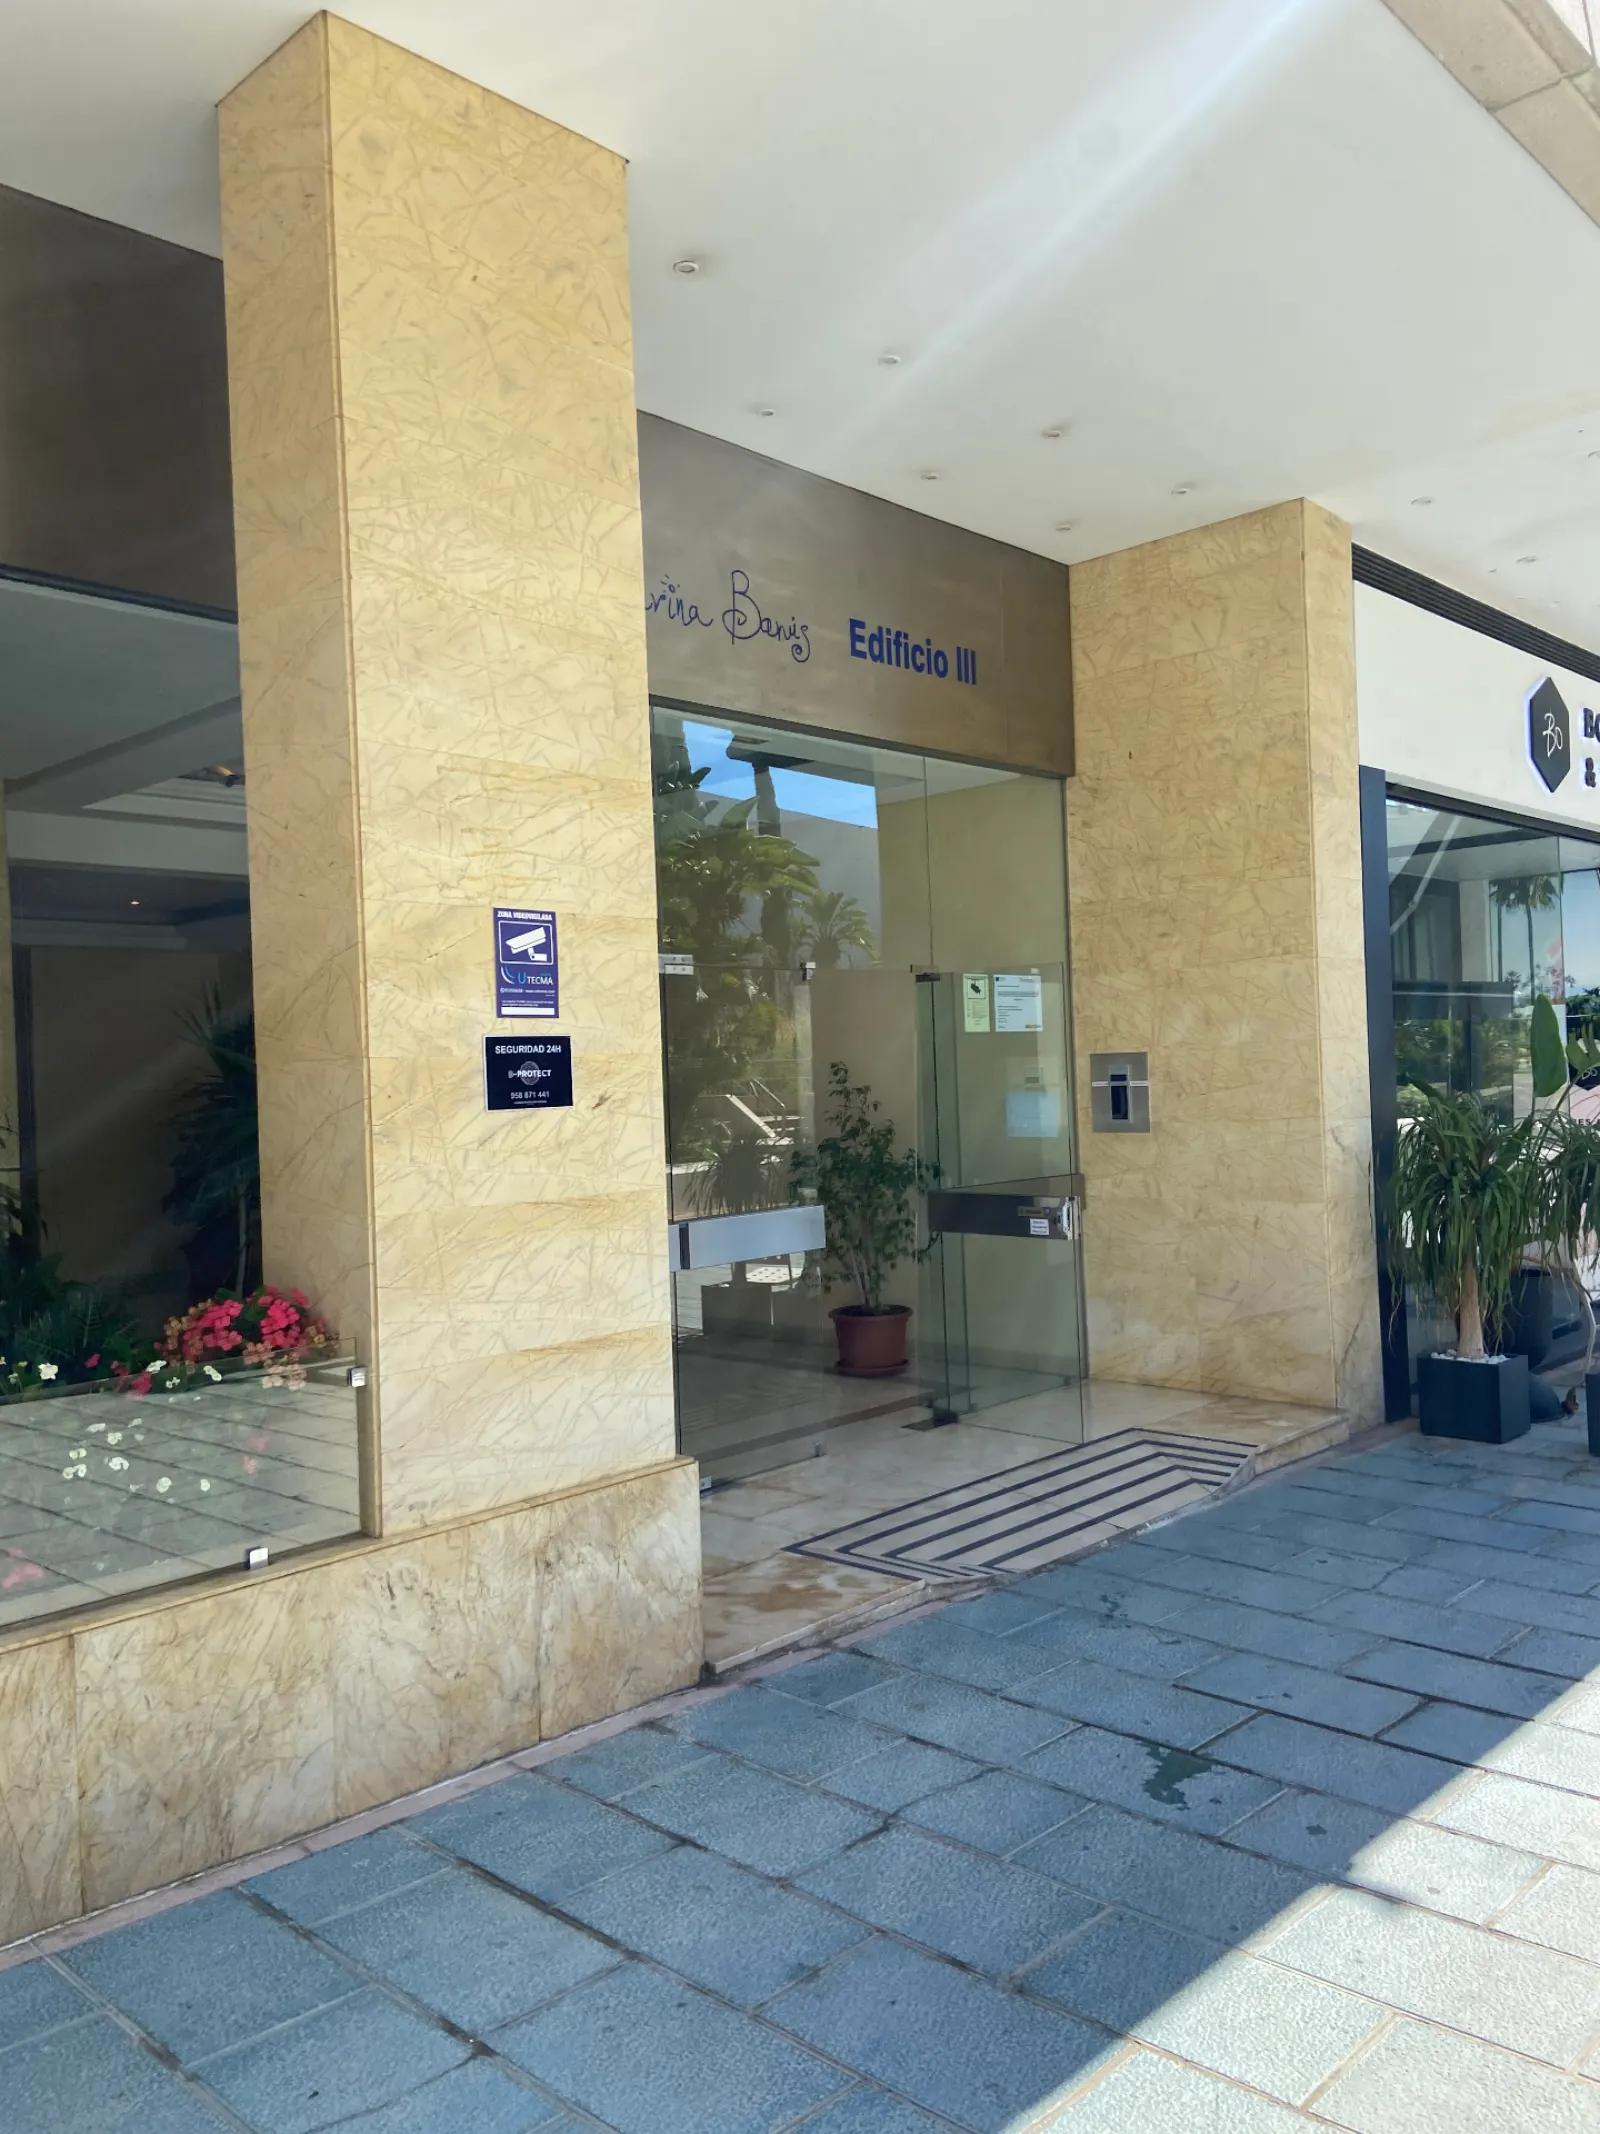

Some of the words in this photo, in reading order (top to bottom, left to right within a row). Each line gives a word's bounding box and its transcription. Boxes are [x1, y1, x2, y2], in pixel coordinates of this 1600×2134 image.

[849, 617, 949, 679] Edificio
[956, 646, 977, 685] III
[497, 910, 513, 919] ZONA
[495, 1045, 545, 1054] SEGURIDAD
[546, 1044, 562, 1053] 24H
